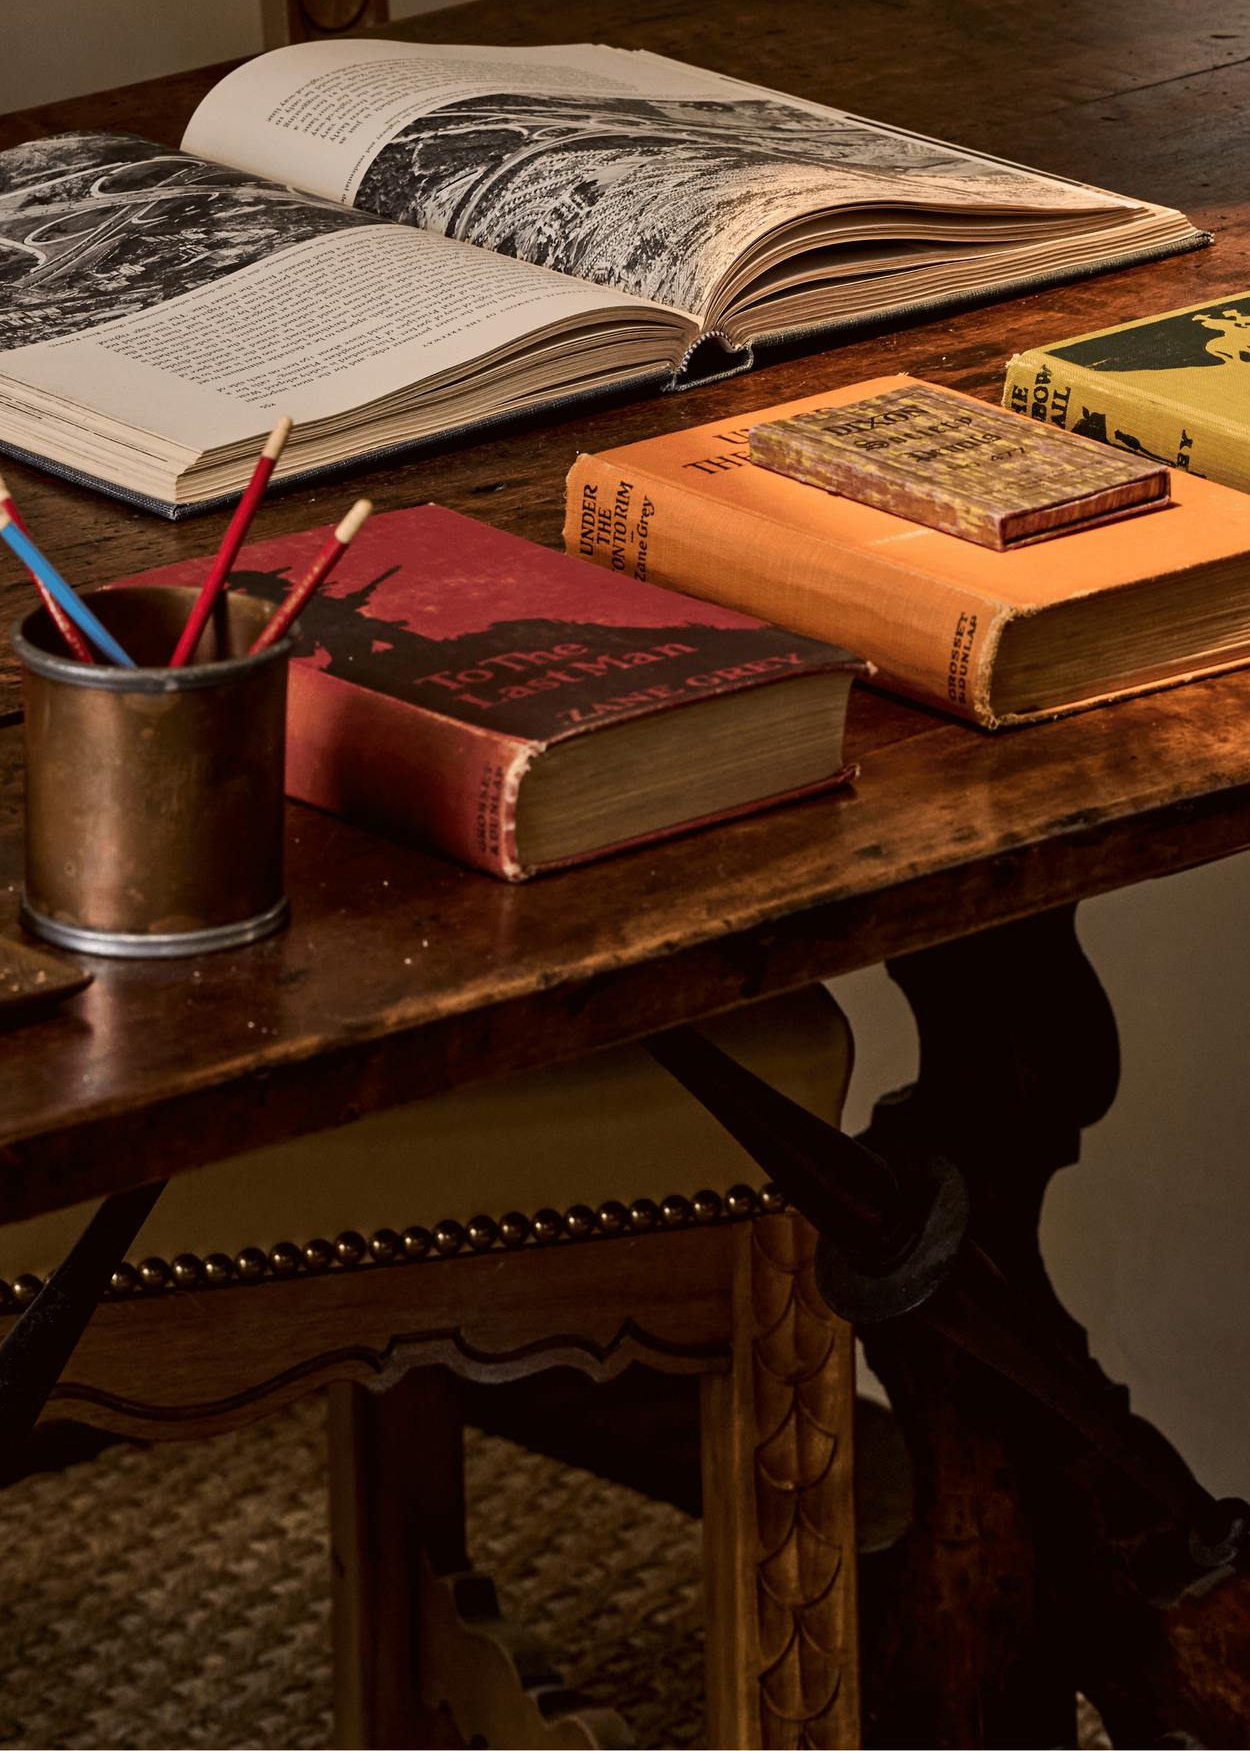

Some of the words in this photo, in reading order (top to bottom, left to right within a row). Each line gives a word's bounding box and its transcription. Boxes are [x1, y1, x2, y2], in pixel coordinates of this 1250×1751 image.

[329, 121, 350, 142] fairly
[344, 154, 366, 192] residential
[821, 404, 930, 436] DIXON
[1051, 386, 1071, 430] AIL
[854, 416, 972, 452] Society
[901, 432, 1002, 463] Pencils
[991, 446, 1026, 462] 477
[579, 483, 599, 557] UNDER
[614, 480, 634, 521] RIM
[636, 494, 655, 538] Grey
[596, 506, 612, 545] THE
[611, 520, 627, 572] ONTO
[634, 540, 648, 583] Zane
[412, 669, 495, 690] To
[477, 642, 589, 672] The
[453, 669, 586, 710] Last
[565, 642, 699, 676] Man
[685, 652, 805, 687] GREY
[947, 611, 968, 702] GROSSET
